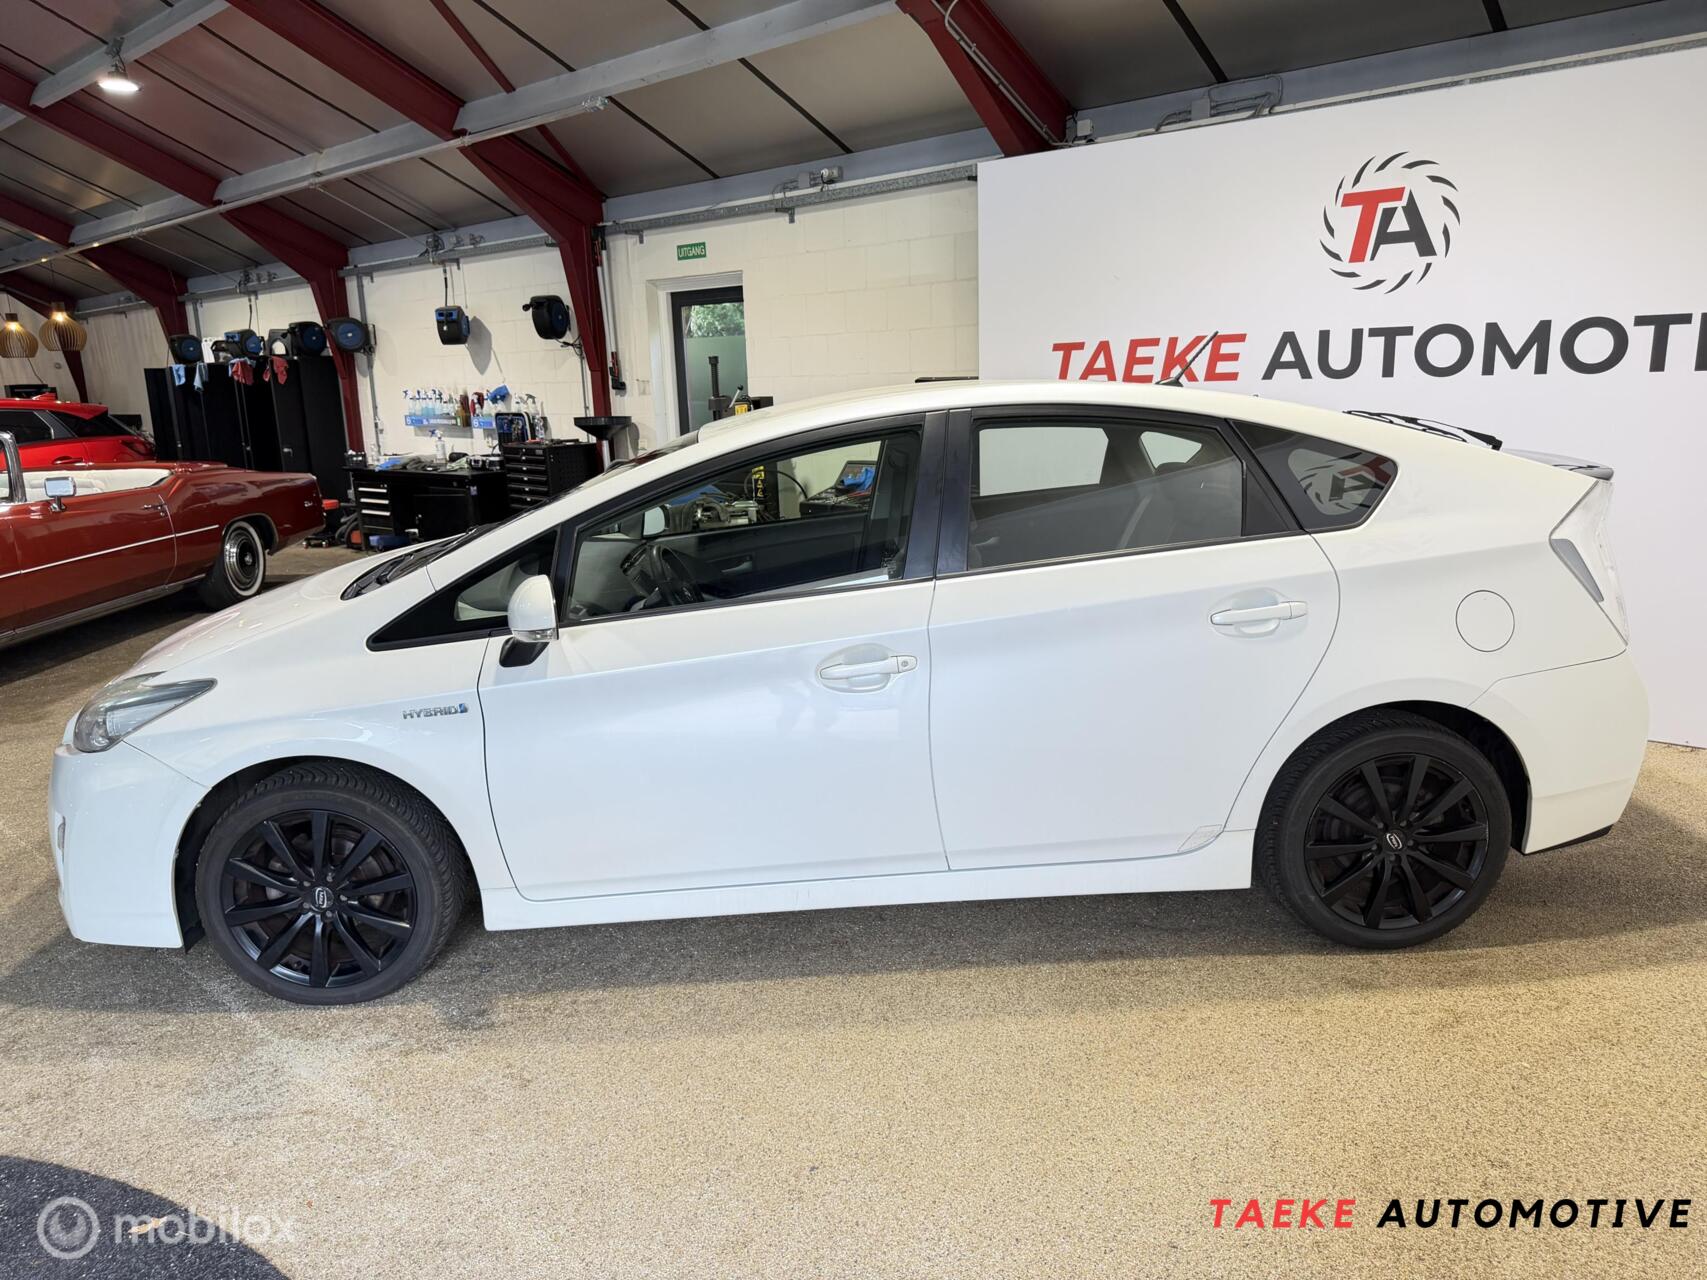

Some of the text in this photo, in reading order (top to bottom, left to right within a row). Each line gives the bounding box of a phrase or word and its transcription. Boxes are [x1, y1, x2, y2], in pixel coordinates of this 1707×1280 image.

[1341, 186, 1438, 264] TA
[678, 244, 705, 258] UITGANG
[1052, 333, 1247, 384] TAEKE
[402, 705, 458, 720] HYBRID
